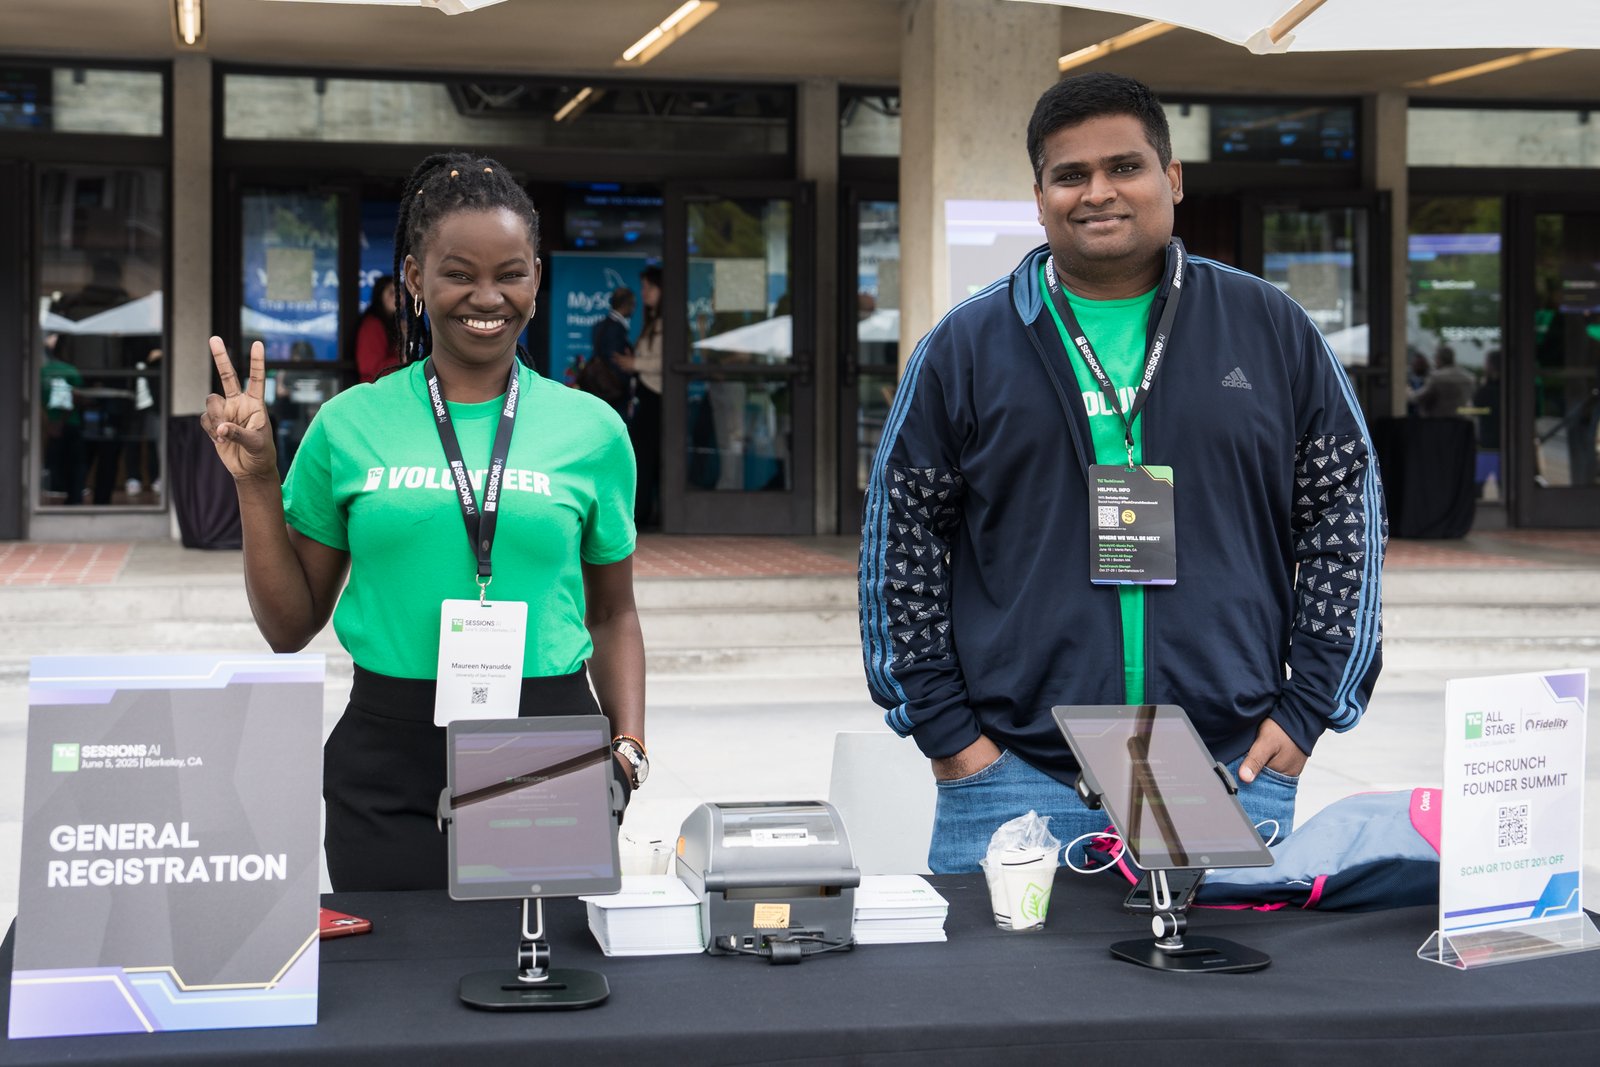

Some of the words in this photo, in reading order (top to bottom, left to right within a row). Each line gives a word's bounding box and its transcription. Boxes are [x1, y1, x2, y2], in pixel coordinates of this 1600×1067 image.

[1080, 344, 1105, 380] SESSIONS
[1144, 341, 1164, 381] SESSIONS
[506, 379, 519, 411] SESSIONS
[1222, 380, 1252, 390] adidas
[388, 466, 552, 496] VOLUNEER
[454, 466, 472, 505] SESSIONS
[466, 506, 476, 514] AI
[487, 464, 502, 501] SESSIONS
[1486, 712, 1503, 722] ALL
[1535, 718, 1568, 729] Fidelity
[1485, 723, 1515, 736] STAGE
[81, 744, 147, 758] SESSIONS
[147, 744, 161, 756] AI
[81, 759, 103, 769] June
[104, 759, 113, 769] 5,
[115, 758, 138, 768] 2025
[145, 758, 185, 768] Berkeley,
[187, 757, 203, 766] CA
[1464, 756, 1546, 776] TECHCRUNCH
[1464, 778, 1518, 796] FOUNDER
[1521, 773, 1567, 790] SUMMIT
[50, 822, 199, 852] GENERAL
[48, 854, 287, 887] REGISTRATION
[1460, 865, 1484, 876] SCAN
[1486, 863, 1498, 873] QR
[1500, 862, 1512, 871] TO
[1514, 859, 1529, 869] GET
[1531, 857, 1547, 867] 20%
[1549, 854, 1564, 865] OFF
